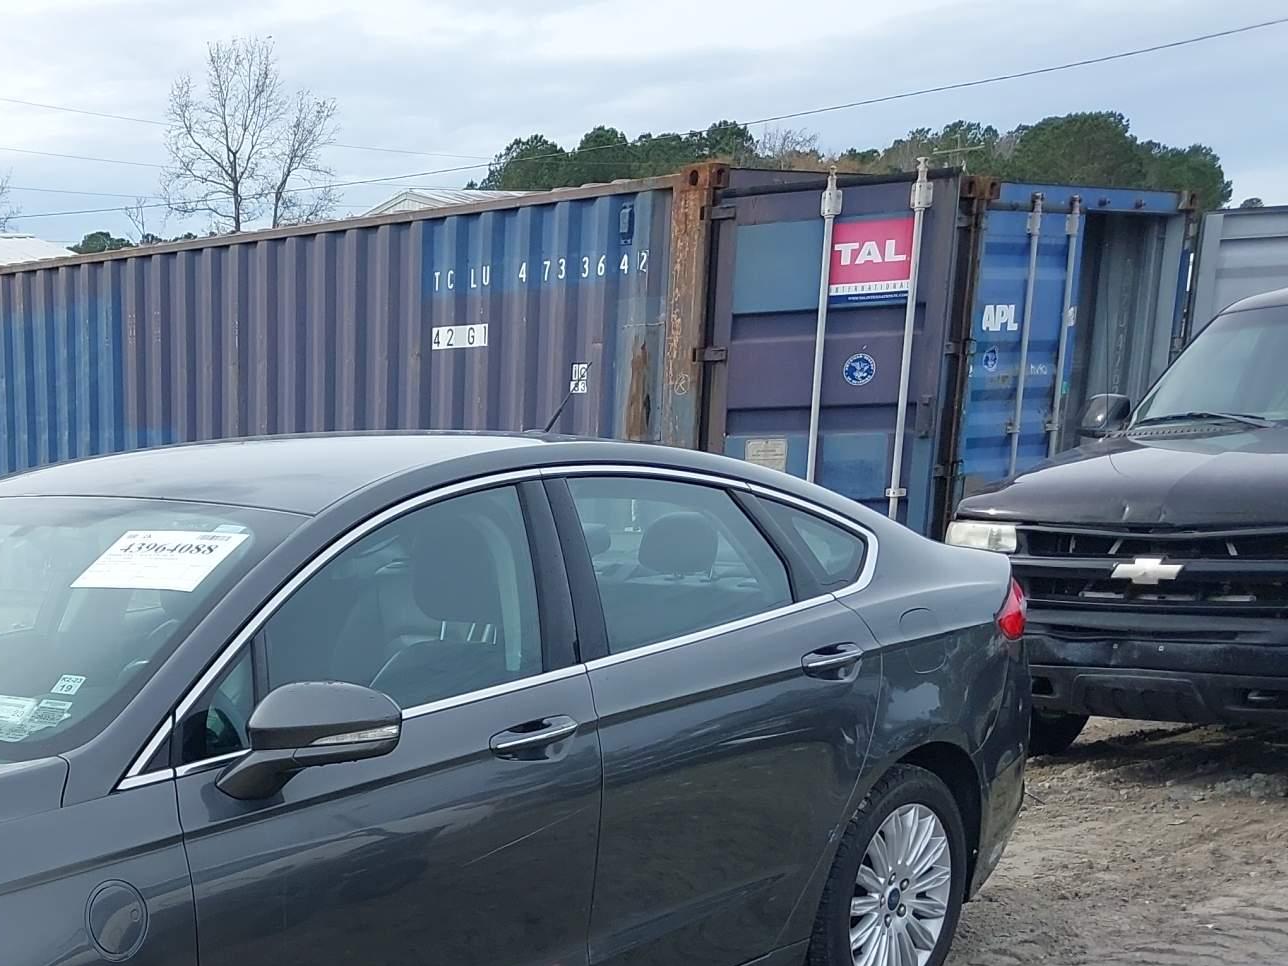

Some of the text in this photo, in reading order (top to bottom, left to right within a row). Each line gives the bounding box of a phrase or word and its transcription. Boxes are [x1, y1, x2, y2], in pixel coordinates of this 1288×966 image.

[834, 240, 907, 266] TAL
[982, 304, 1018, 332] APL
[120, 542, 219, 556] 43964088
